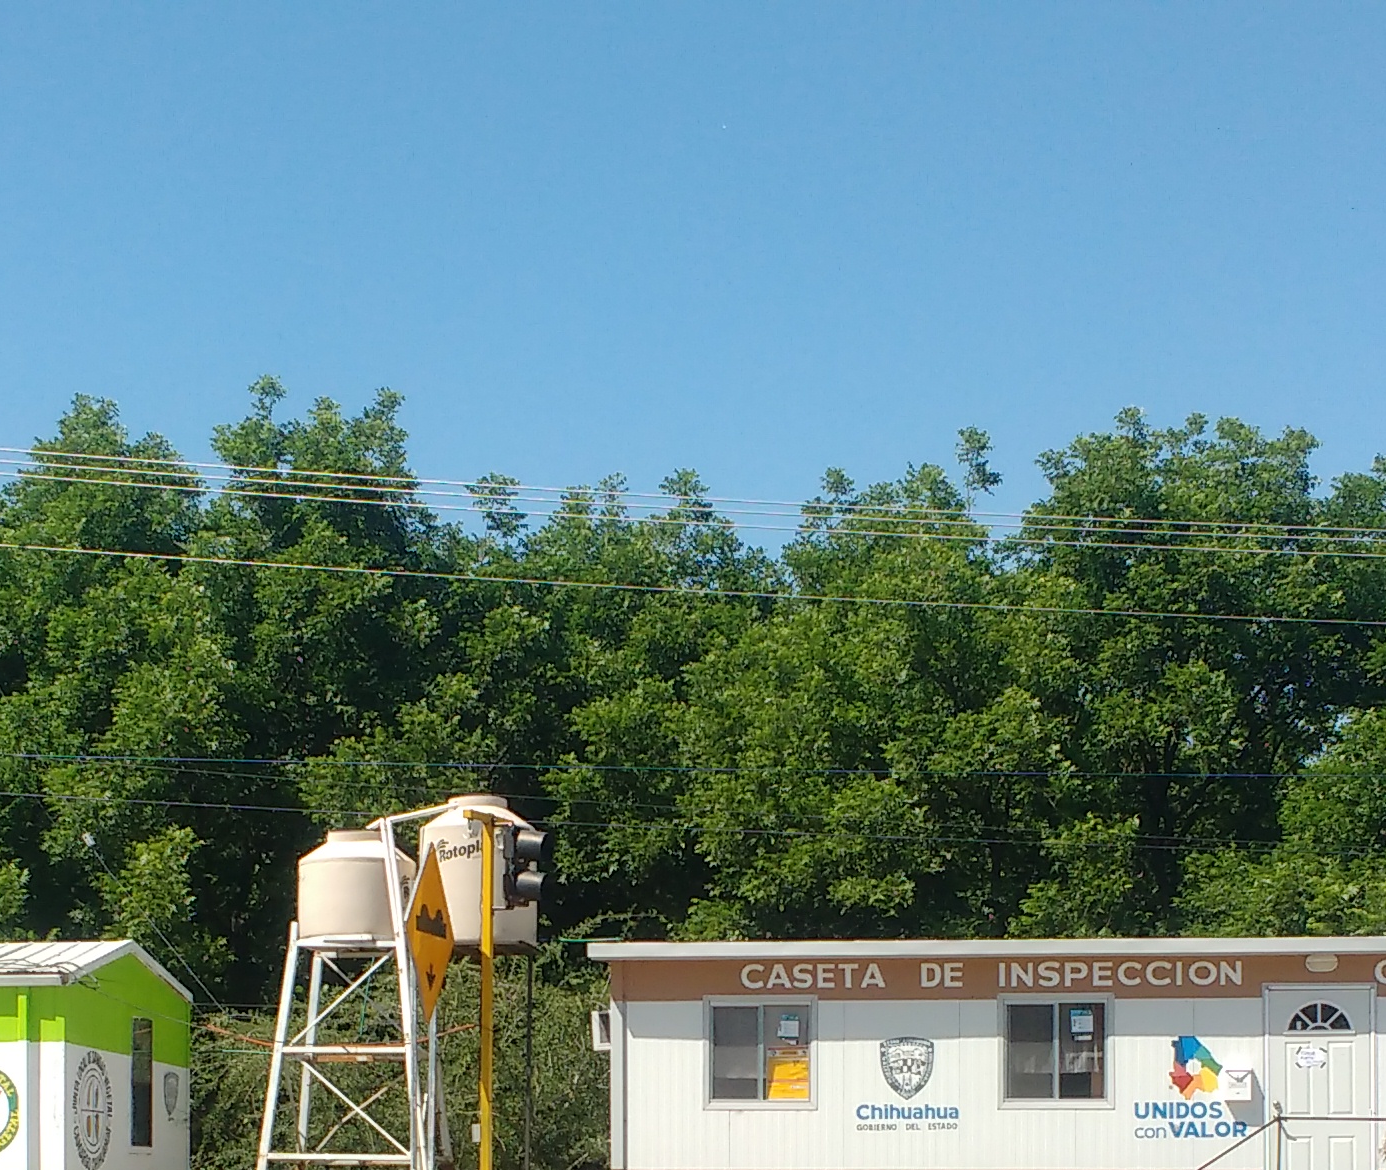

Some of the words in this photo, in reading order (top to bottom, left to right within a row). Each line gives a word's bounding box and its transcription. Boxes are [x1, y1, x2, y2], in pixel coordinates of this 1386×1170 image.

[439, 840, 482, 862] Rotopl
[740, 963, 886, 989] CASETA
[920, 962, 964, 988] DE
[998, 961, 1243, 988] INSPECCION
[856, 1104, 959, 1120] Chihuahua
[1134, 1101, 1223, 1119] UNIDOS
[856, 1123, 897, 1131] GOBIERNO
[905, 1123, 920, 1131] DEL
[928, 1122, 958, 1131] ESTADO
[1134, 1127, 1167, 1139] con
[1168, 1121, 1247, 1138] VALOR
